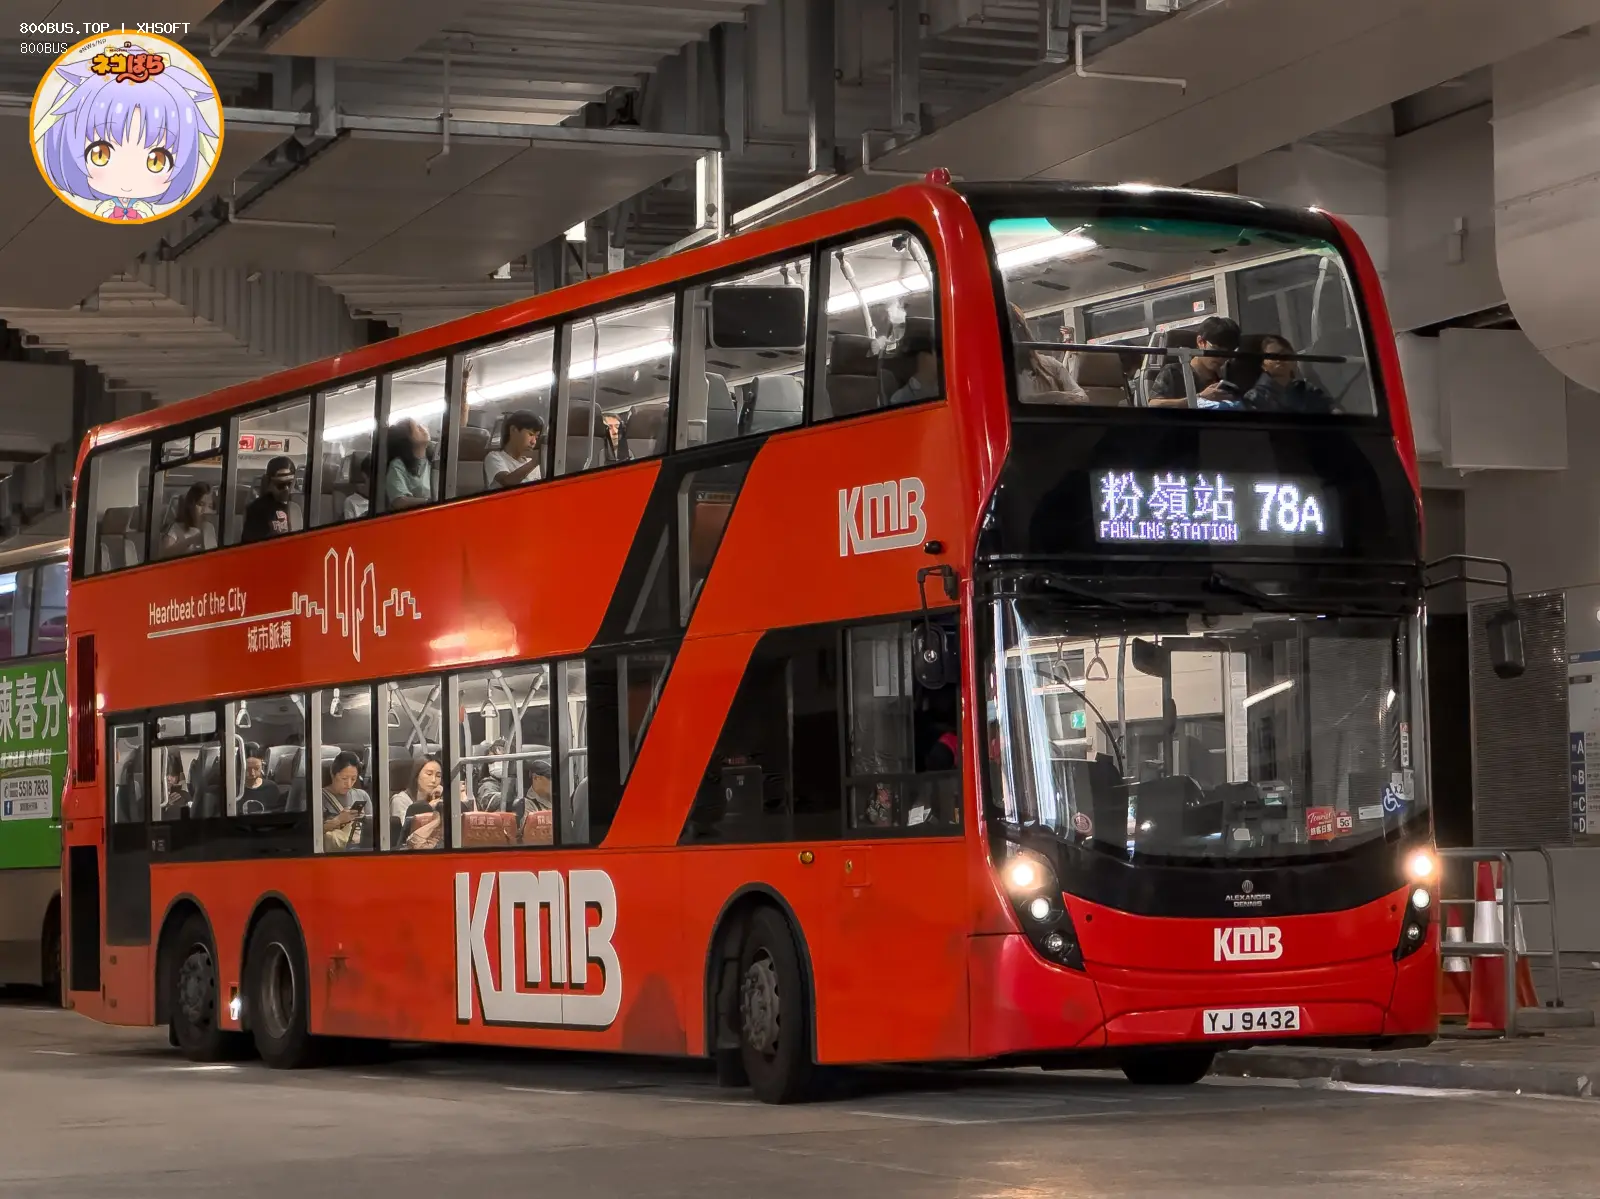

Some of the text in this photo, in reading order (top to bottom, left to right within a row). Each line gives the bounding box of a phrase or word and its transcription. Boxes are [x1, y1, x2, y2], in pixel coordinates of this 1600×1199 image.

[1100, 469, 1236, 521] 粉嶺站
[1253, 483, 1324, 533] 78A
[838, 476, 927, 557] KMB
[1100, 521, 1238, 541] FANLING STATION
[149, 587, 247, 626] Heartbeat of the City
[1577, 739, 1585, 755] A
[1578, 769, 1585, 785] B
[1578, 796, 1586, 812] C
[1579, 817, 1586, 833] D
[454, 870, 622, 1029] KMB
[1213, 926, 1284, 962] KMB
[1208, 1010, 1296, 1032] YJ 9432
